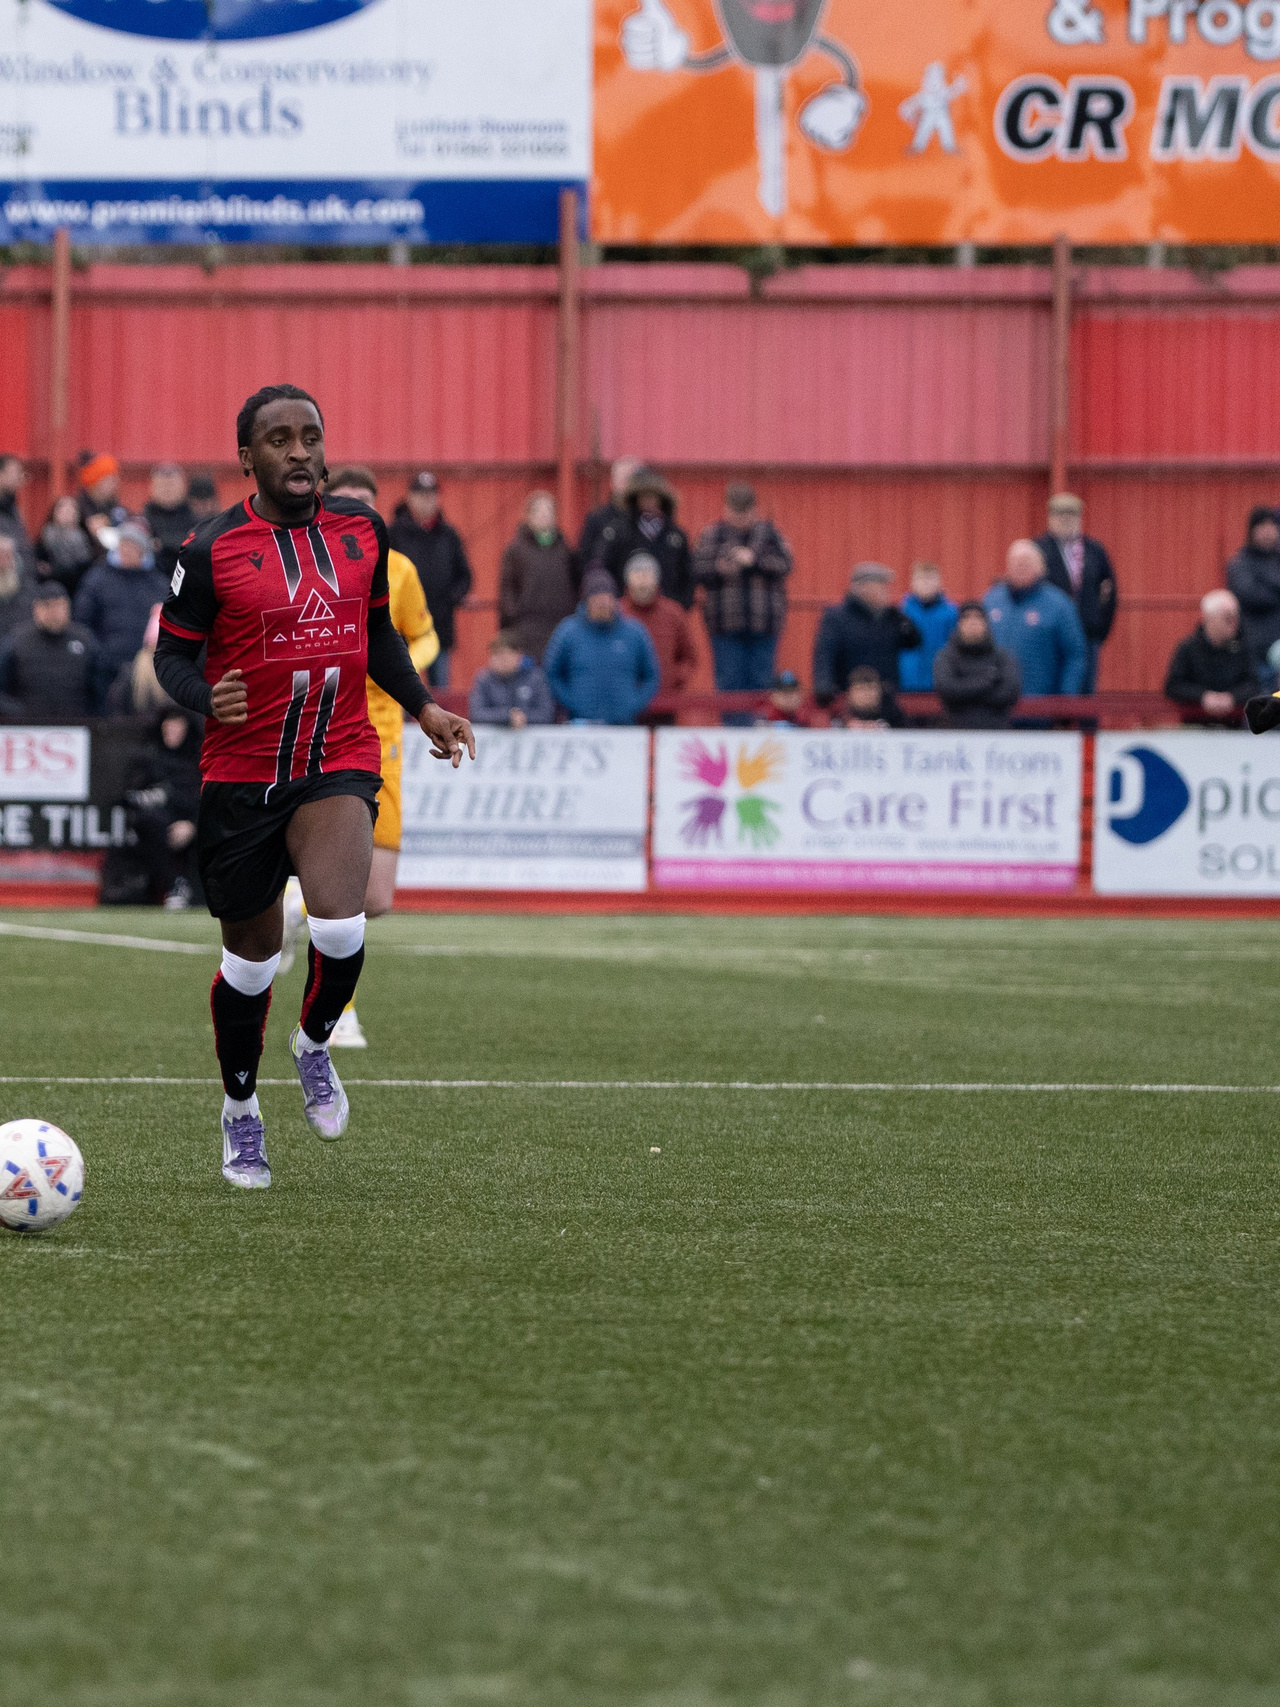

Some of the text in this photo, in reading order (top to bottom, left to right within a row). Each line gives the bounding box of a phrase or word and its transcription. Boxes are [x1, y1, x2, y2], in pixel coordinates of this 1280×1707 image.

[1047, 0, 1280, 61] & Prog
[152, 54, 179, 84] &
[193, 52, 436, 92] Conservatory
[112, 82, 305, 137] Blinds
[999, 82, 1129, 152] CR
[272, 623, 356, 643] ALTAIR
[295, 640, 339, 650] GROUP
[803, 740, 887, 772] Skills
[899, 741, 971, 773] Tank
[462, 783, 582, 820] HIRE
[800, 778, 1057, 831] Care First
